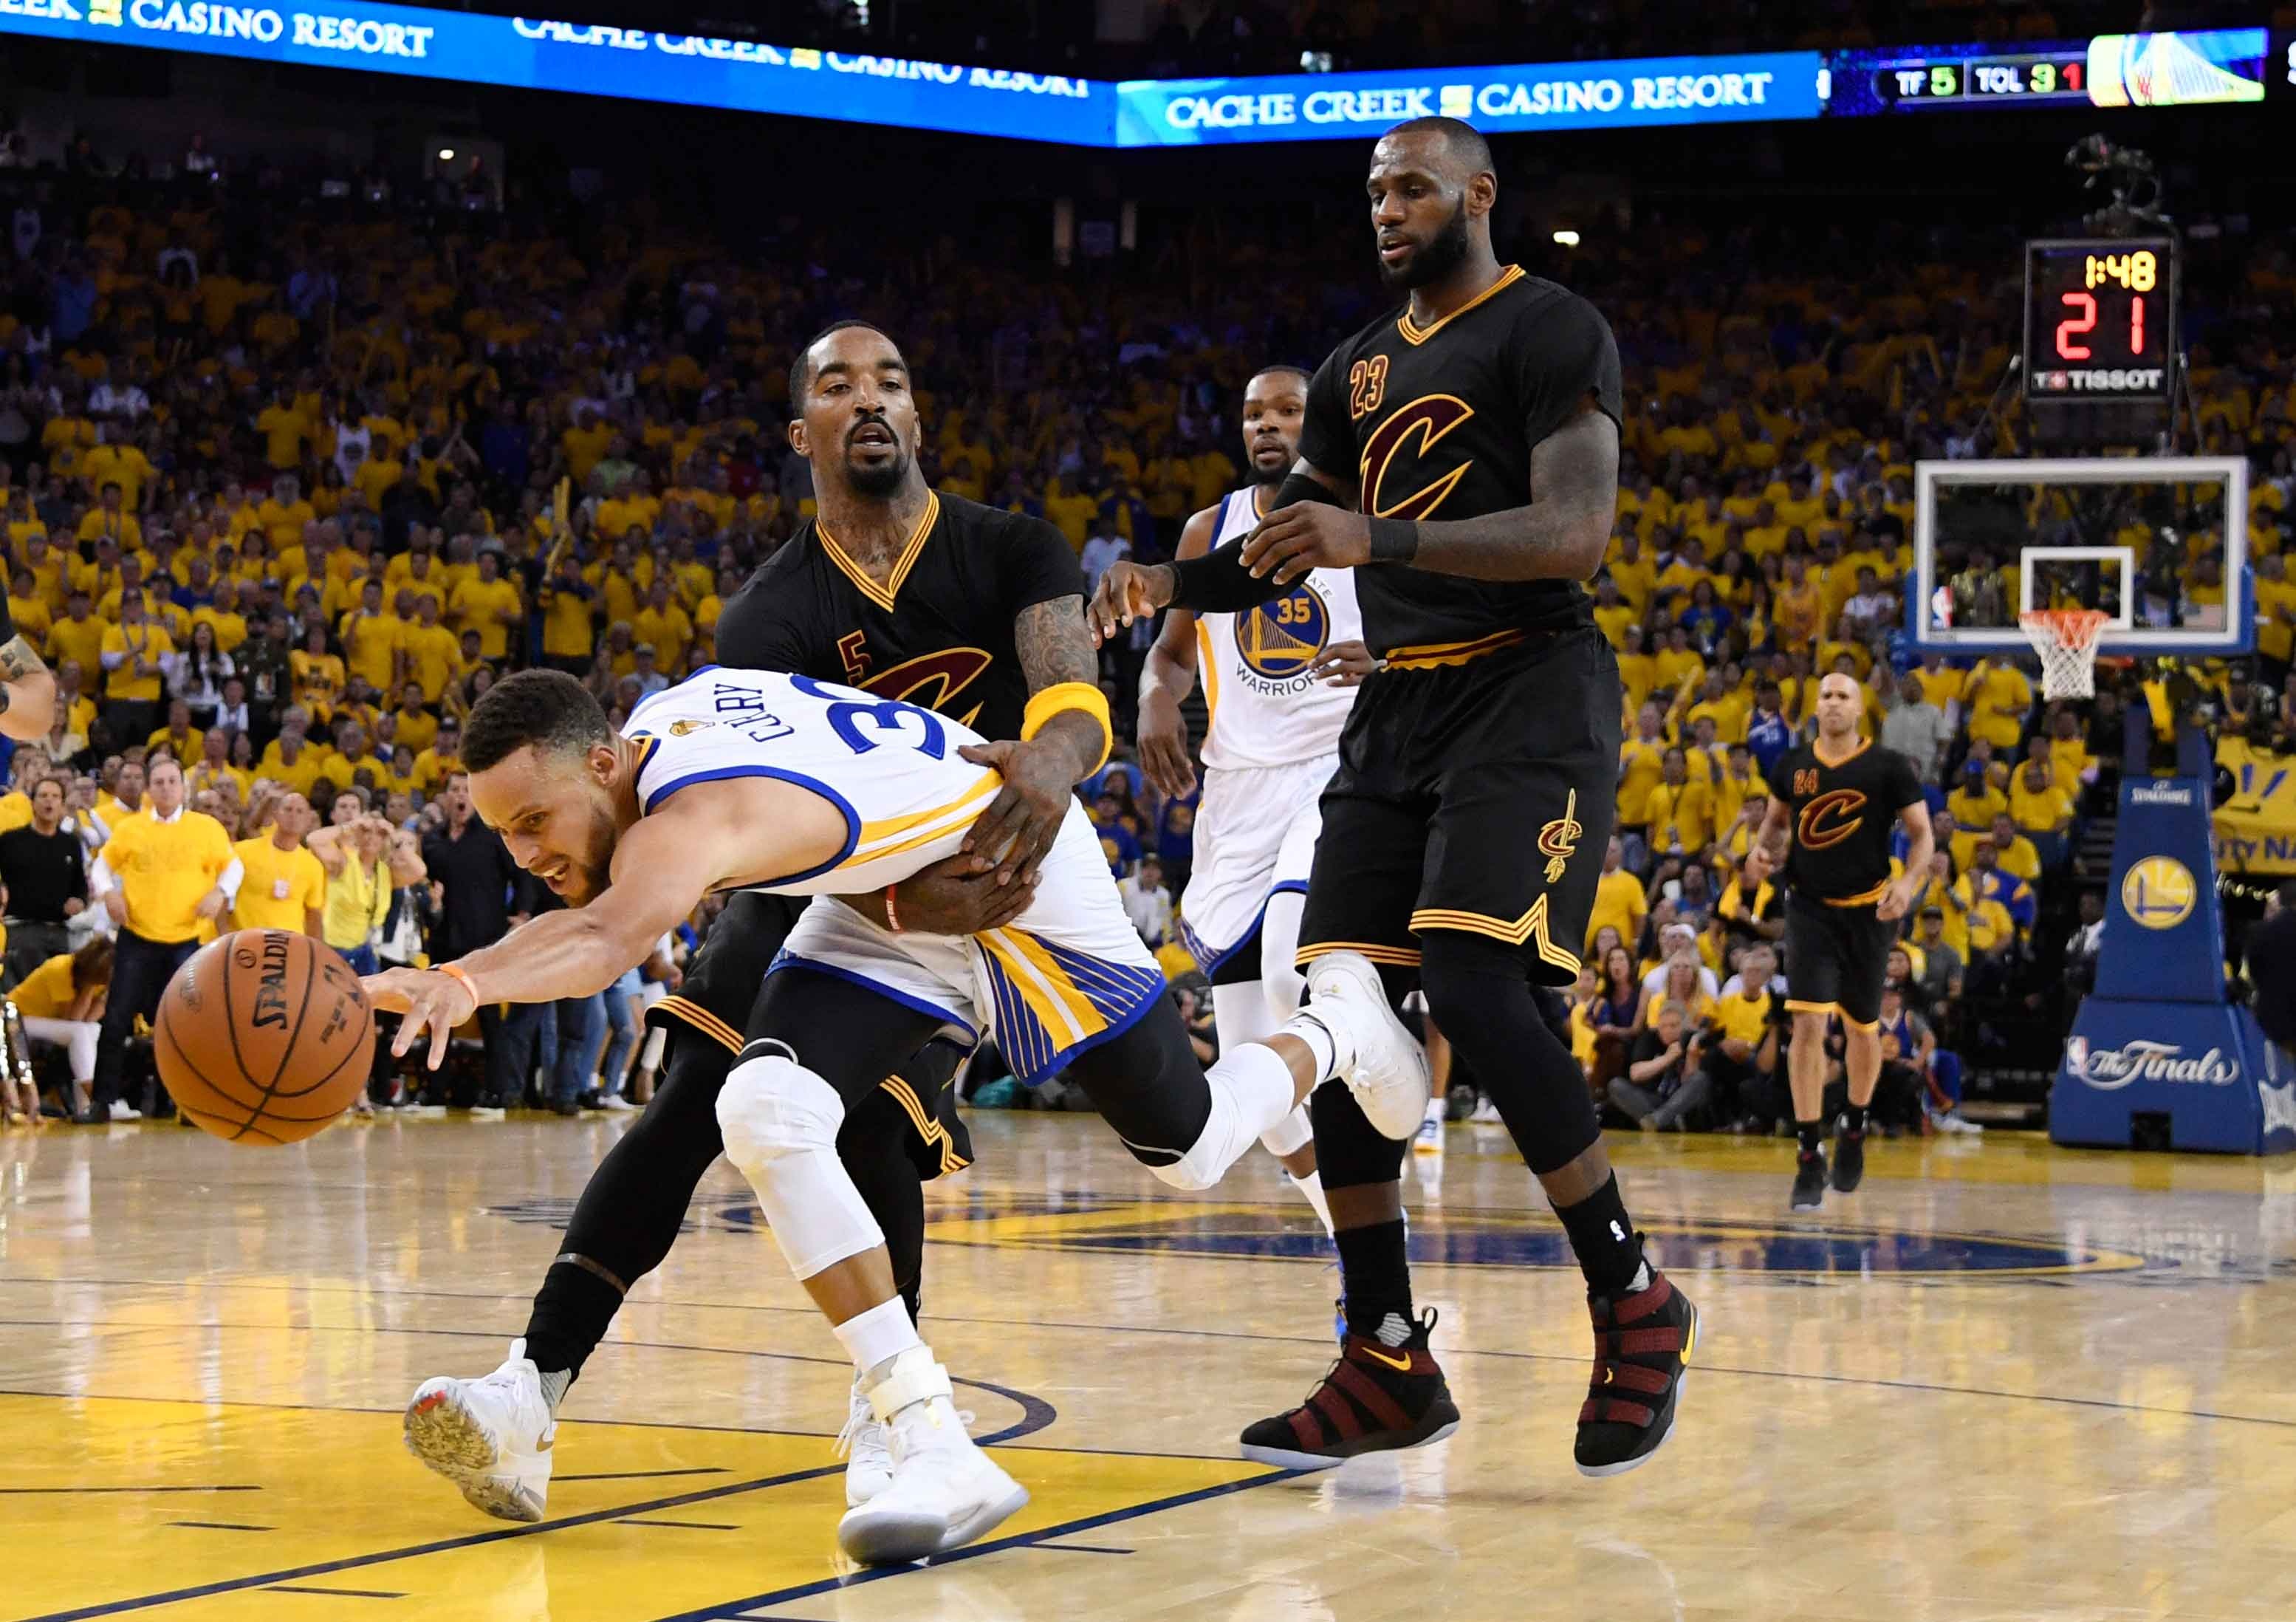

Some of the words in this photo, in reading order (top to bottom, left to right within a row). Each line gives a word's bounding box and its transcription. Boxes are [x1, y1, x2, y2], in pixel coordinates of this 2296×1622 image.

[129, 0, 284, 43] CASINO
[292, 13, 434, 58] RESORT
[1165, 93, 1296, 129] CACHE
[1303, 86, 1436, 124] CREEK
[1477, 78, 1624, 117] CASINO
[1630, 72, 1773, 110] RESORT
[1895, 70, 1927, 96] TF
[1930, 67, 1957, 97] 5
[1975, 66, 2025, 95] TOL
[2085, 250, 2157, 292] 1:48
[2055, 292, 2144, 360] 21
[1349, 354, 1389, 420] 23
[2067, 369, 2164, 391] TISSOT
[1276, 597, 1312, 625] 35
[836, 629, 873, 687] 5
[2080, 1039, 2241, 1091] Finals
